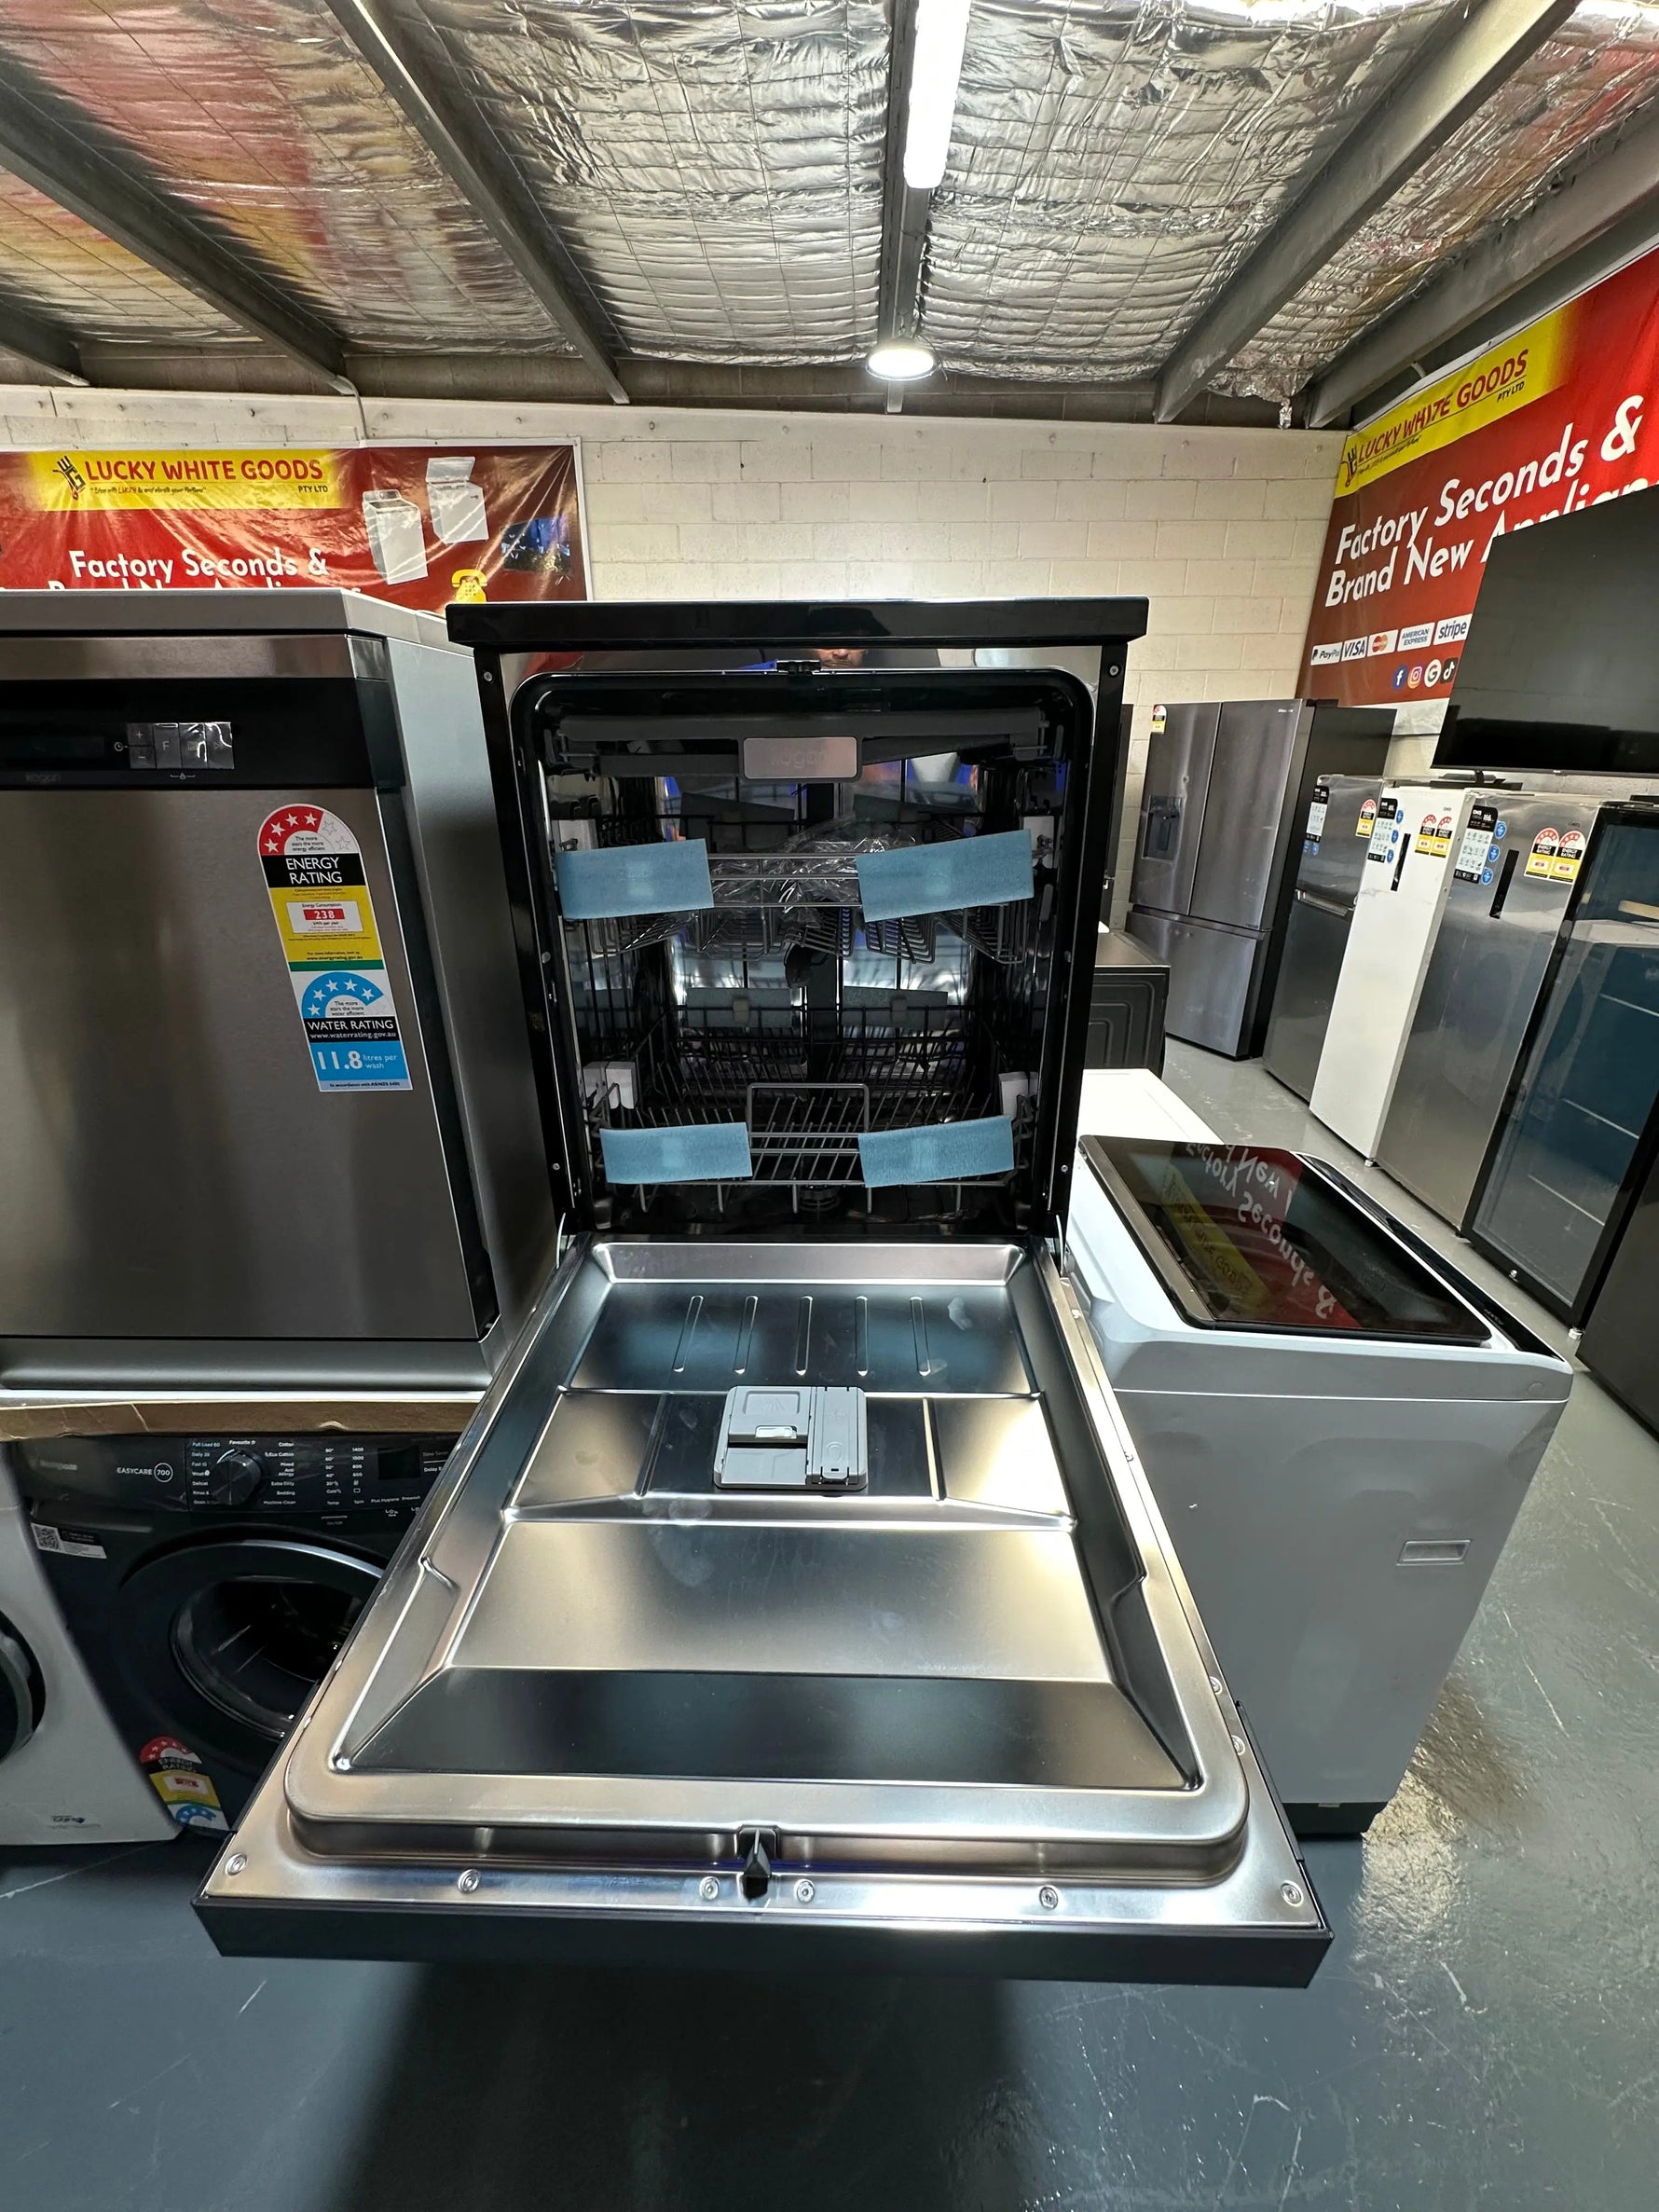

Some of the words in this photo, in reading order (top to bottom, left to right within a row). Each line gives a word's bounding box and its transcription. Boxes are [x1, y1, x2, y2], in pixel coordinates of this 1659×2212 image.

[1497, 387, 1512, 403] PTY
[1510, 381, 1525, 395] LTD
[1358, 423, 1401, 463] LUCKY
[1403, 392, 1453, 440] WHITE
[1457, 349, 1529, 408] GOODS
[85, 460, 156, 481] LUCKY
[161, 460, 237, 481] WHITE
[240, 459, 323, 480] GOODS
[297, 485, 312, 493] PTY
[314, 484, 328, 493] LTD
[1335, 506, 1429, 565] Factory
[1434, 422, 1589, 528] Seconds
[1600, 394, 1644, 461] &
[68, 550, 174, 584] Factory
[181, 546, 299, 577] Seconds
[307, 547, 330, 576] &
[1325, 545, 1398, 608] Brand
[1403, 536, 1474, 585] New
[1402, 627, 1430, 639] AMERICAN
[1438, 621, 1467, 640] stripe
[1344, 640, 1365, 658] VISA
[1403, 636, 1429, 646] EXPRESS
[285, 857, 339, 871] ENERGY
[289, 871, 343, 885] RATING
[313, 910, 336, 920] 238
[308, 1021, 349, 1031] WATER
[350, 1019, 394, 1030] RATING
[317, 1050, 363, 1070] 11.8
[117, 1466, 153, 1476] EASYCARE
[157, 1468, 171, 1477] 700
